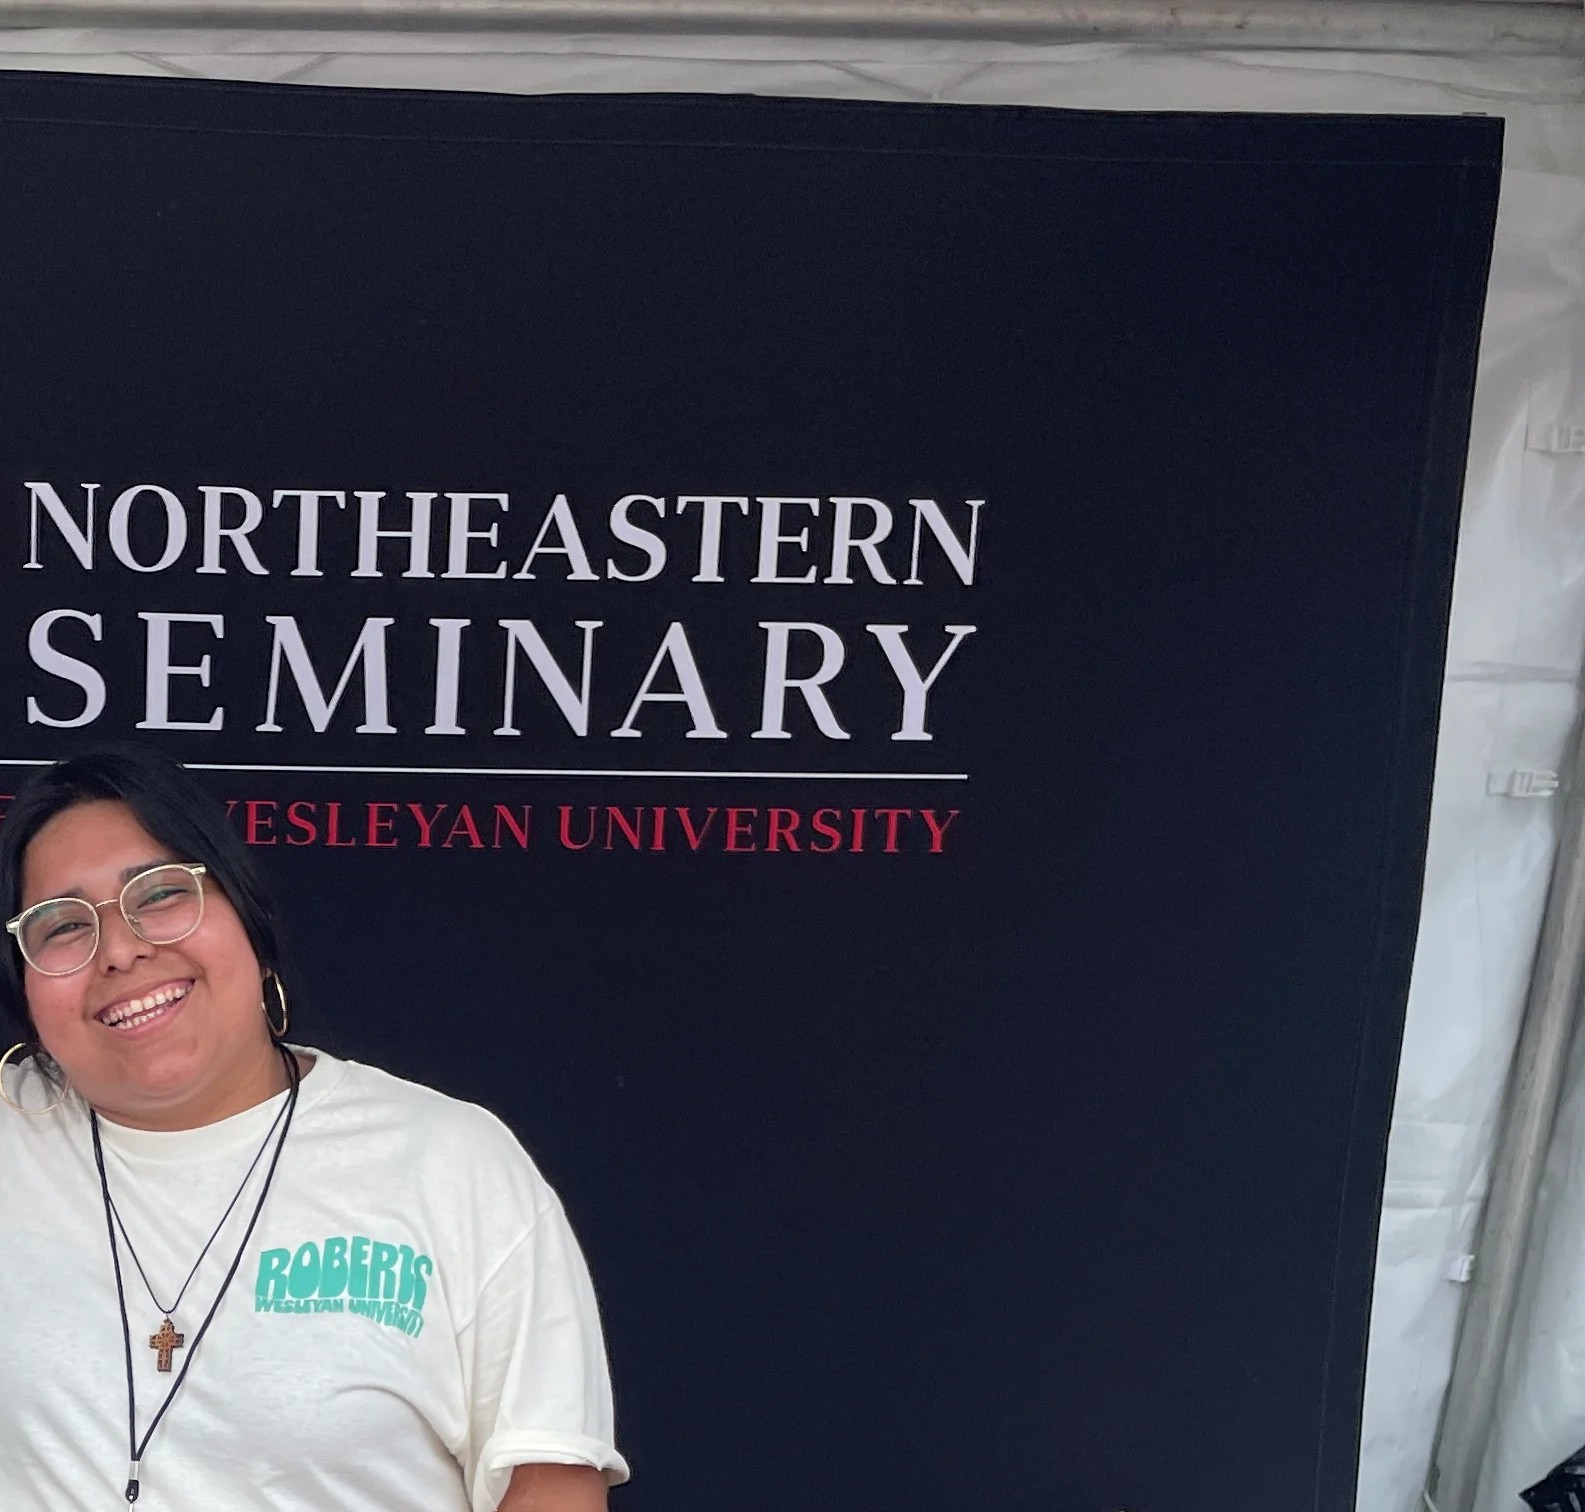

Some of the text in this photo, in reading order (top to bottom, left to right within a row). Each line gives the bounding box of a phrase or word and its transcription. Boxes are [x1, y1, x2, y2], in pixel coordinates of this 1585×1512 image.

[23, 481, 985, 586] NORTHEASTERN
[25, 607, 977, 742] SEMINARY
[557, 804, 963, 854] UNIVERSITY
[255, 1236, 433, 1312] ROBERTS
